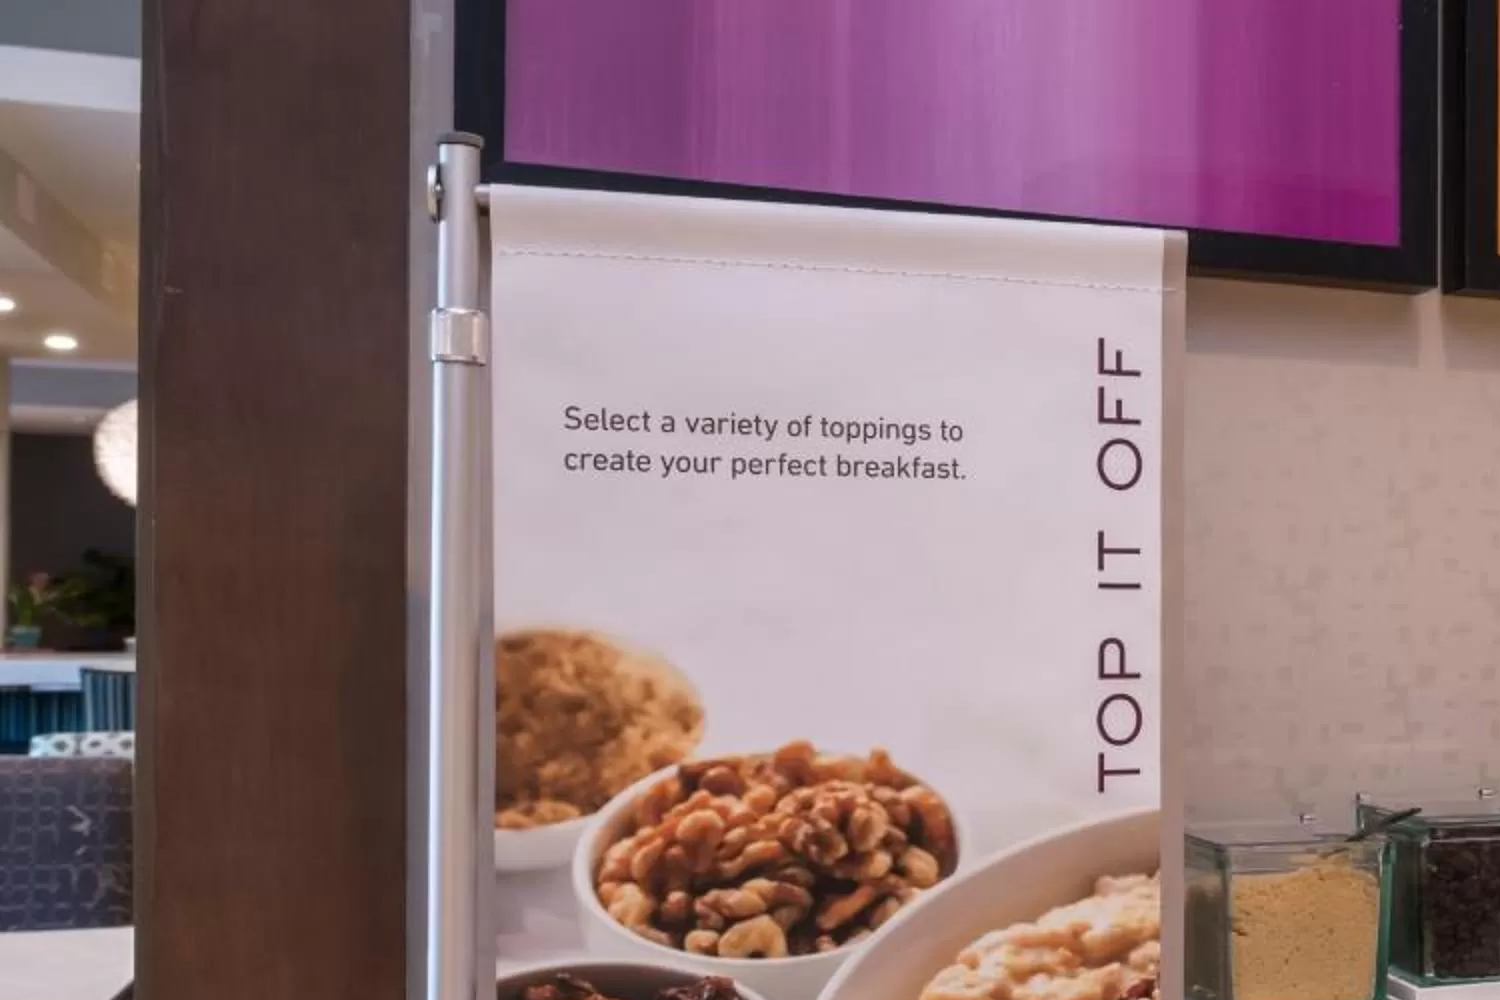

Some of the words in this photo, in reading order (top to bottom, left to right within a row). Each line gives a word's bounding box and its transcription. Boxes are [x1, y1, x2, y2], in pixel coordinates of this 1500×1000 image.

[563, 405, 651, 433] Select
[660, 415, 676, 433] a
[684, 411, 779, 442] variety
[787, 415, 813, 438] of
[819, 416, 932, 446] toppings
[940, 420, 964, 442] to
[1096, 337, 1143, 492] OFF
[563, 449, 652, 473] create
[660, 455, 723, 479] your
[731, 452, 828, 481] perfect
[836, 453, 966, 480] breakfast.
[1097, 530, 1142, 590] IT
[1096, 637, 1143, 794] TOP
